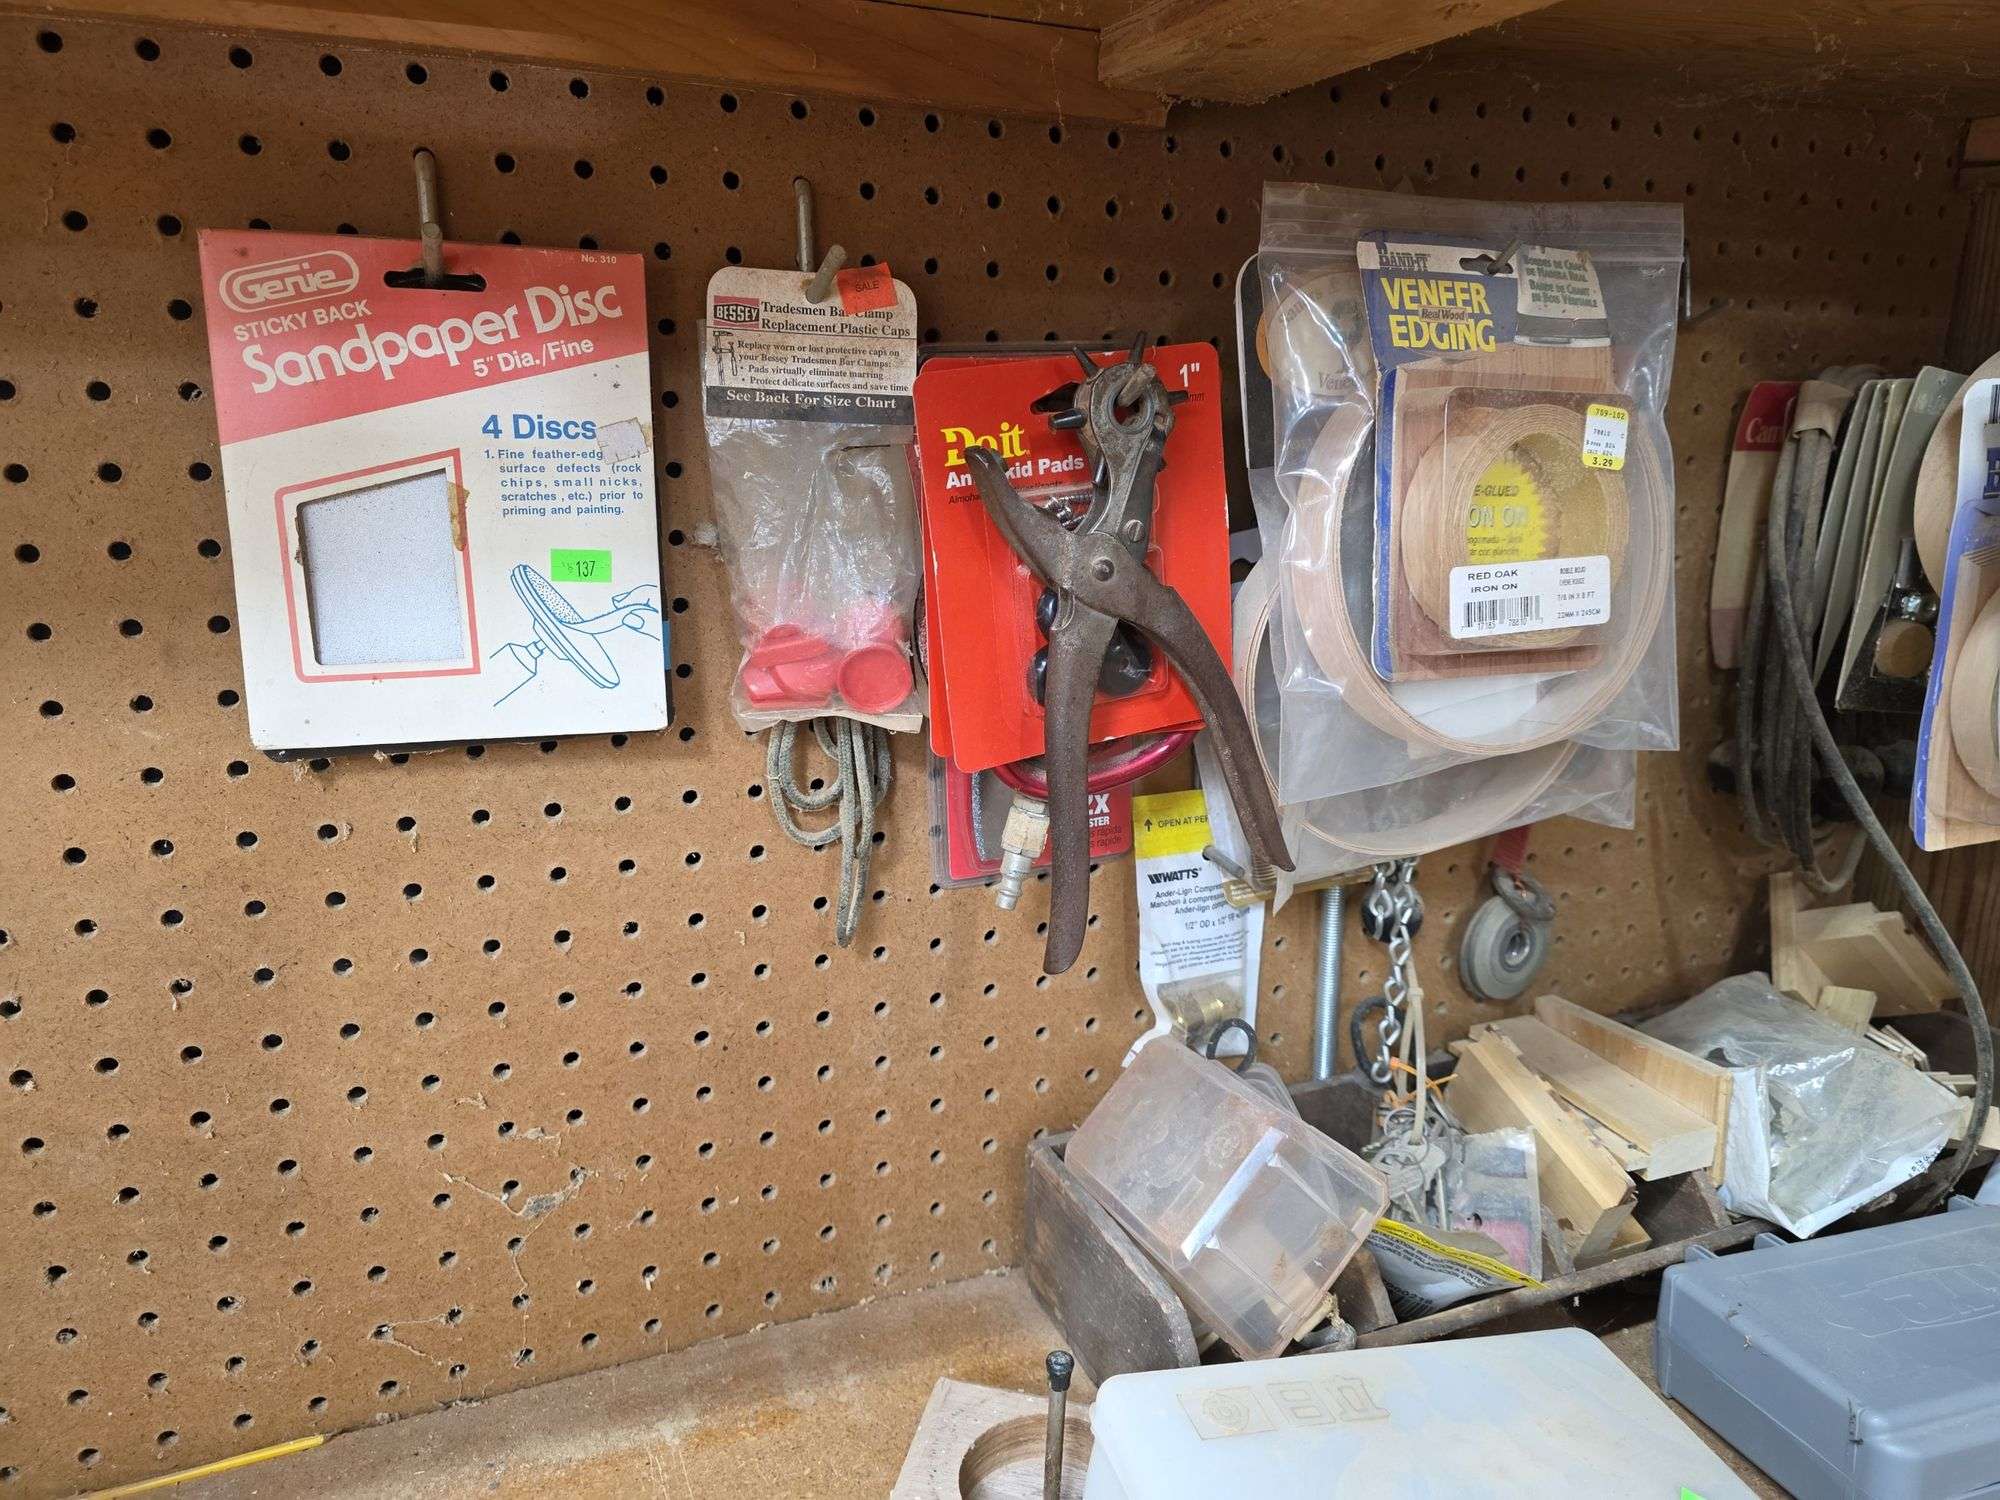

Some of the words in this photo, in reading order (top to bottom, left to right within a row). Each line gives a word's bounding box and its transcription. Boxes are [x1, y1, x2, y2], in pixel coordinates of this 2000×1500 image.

[580, 254, 597, 264] No.
[600, 255, 617, 264] 310
[232, 261, 351, 304] Genie
[855, 279, 879, 293] SALE
[716, 304, 758, 321] BESSEY
[762, 301, 826, 317] Tradesmen
[1421, 308, 1442, 320] Real
[1442, 309, 1465, 321] Wood
[234, 312, 308, 342] STICKY
[312, 299, 372, 326] BACK
[761, 317, 839, 333] Replacement
[840, 322, 878, 335] Plastic
[881, 325, 911, 338] Caps
[242, 304, 521, 394] Sandpaper
[524, 284, 623, 335] Disc
[1388, 314, 1497, 353] EDGING
[738, 340, 771, 351] Replace
[773, 343, 795, 352] worn
[808, 344, 824, 353] lost
[826, 346, 868, 355] protective
[869, 348, 887, 358] caps
[738, 353, 760, 362] your
[761, 353, 789, 364] Bessey
[791, 355, 837, 365] Tradesmen
[839, 357, 856, 366] Bar
[857, 358, 891, 369] Clamps:
[748, 364, 769, 374] Pads
[771, 366, 806, 377] virtually
[808, 368, 848, 377] eliminate
[849, 371, 884, 381] marring
[1179, 362, 1200, 388] 1"
[750, 376, 780, 386] Protect
[782, 378, 815, 388] delicate
[816, 380, 851, 390] surfaces
[852, 381, 868, 390] and
[869, 383, 890, 392] save
[889, 383, 909, 392] time
[726, 389, 751, 402] See
[755, 391, 791, 404] Back
[795, 393, 820, 406] For
[823, 394, 852, 408] Size
[855, 396, 897, 409] Chart
[482, 414, 502, 439] 4
[512, 413, 597, 440] Discs
[484, 449, 495, 459] 1.
[498, 449, 525, 459] Fine
[532, 449, 604, 461] feather-edg
[1592, 456, 1613, 467] 3.29
[499, 463, 546, 473] surface
[556, 463, 601, 473] defects
[611, 463, 642, 475] (rock
[1038, 455, 1085, 475] Pads
[500, 477, 549, 489] chips,
[553, 477, 593, 487] small
[600, 477, 643, 488] nicks,
[600, 491, 625, 502] prior
[633, 490, 643, 500] to
[502, 505, 546, 518] priming
[551, 505, 572, 515] and
[576, 504, 624, 517] painting.
[576, 560, 596, 578] 137
[1467, 571, 1491, 581] RED
[1494, 569, 1518, 578] OAK
[1471, 585, 1498, 593] IRON
[1088, 793, 1110, 815] X
[1088, 815, 1110, 828] STER
[1157, 819, 1182, 828] OPEN
[1183, 816, 1193, 825] AT
[1157, 867, 1200, 884] WATTS
